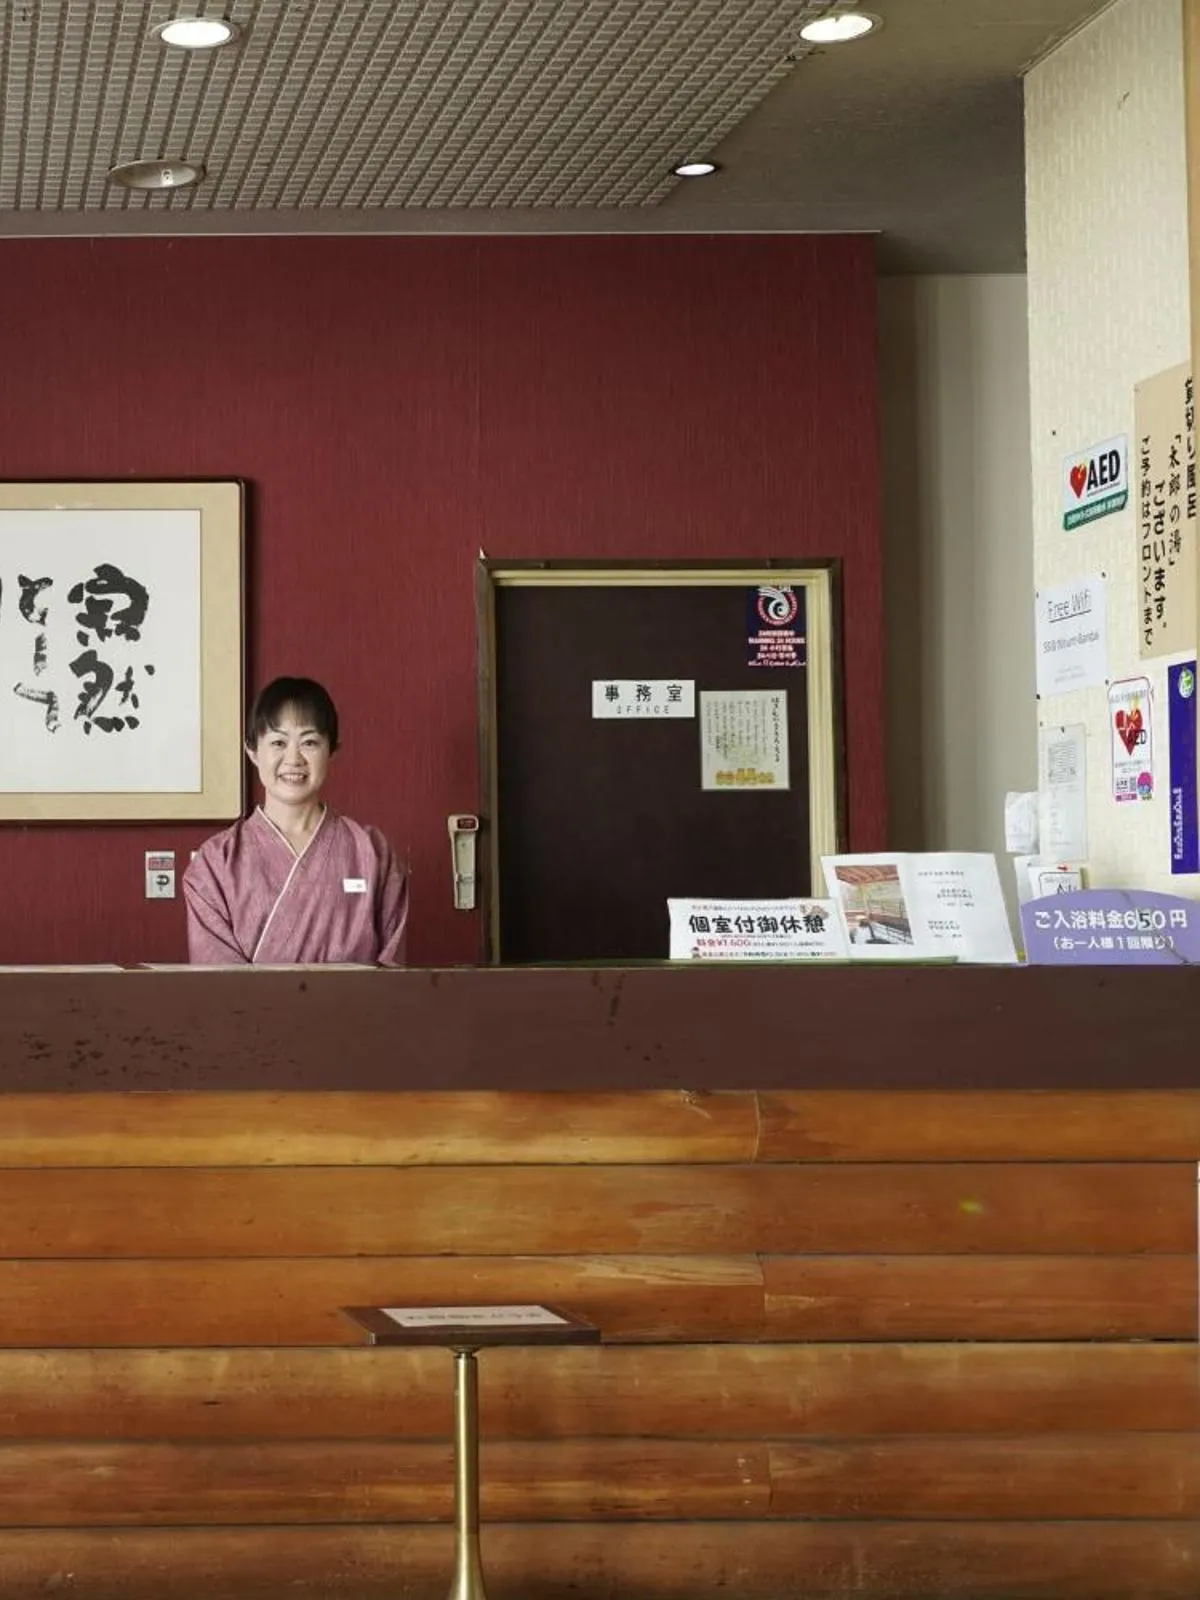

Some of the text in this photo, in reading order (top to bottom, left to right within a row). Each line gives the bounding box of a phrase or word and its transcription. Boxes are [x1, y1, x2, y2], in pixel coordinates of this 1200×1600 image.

[1086, 449, 1121, 491] AED
[605, 684, 682, 702] 事務室
[616, 704, 669, 715] OFFICE
[689, 914, 826, 934] 個室付御休憩
[1035, 909, 1188, 930] ご入浴料金650円
